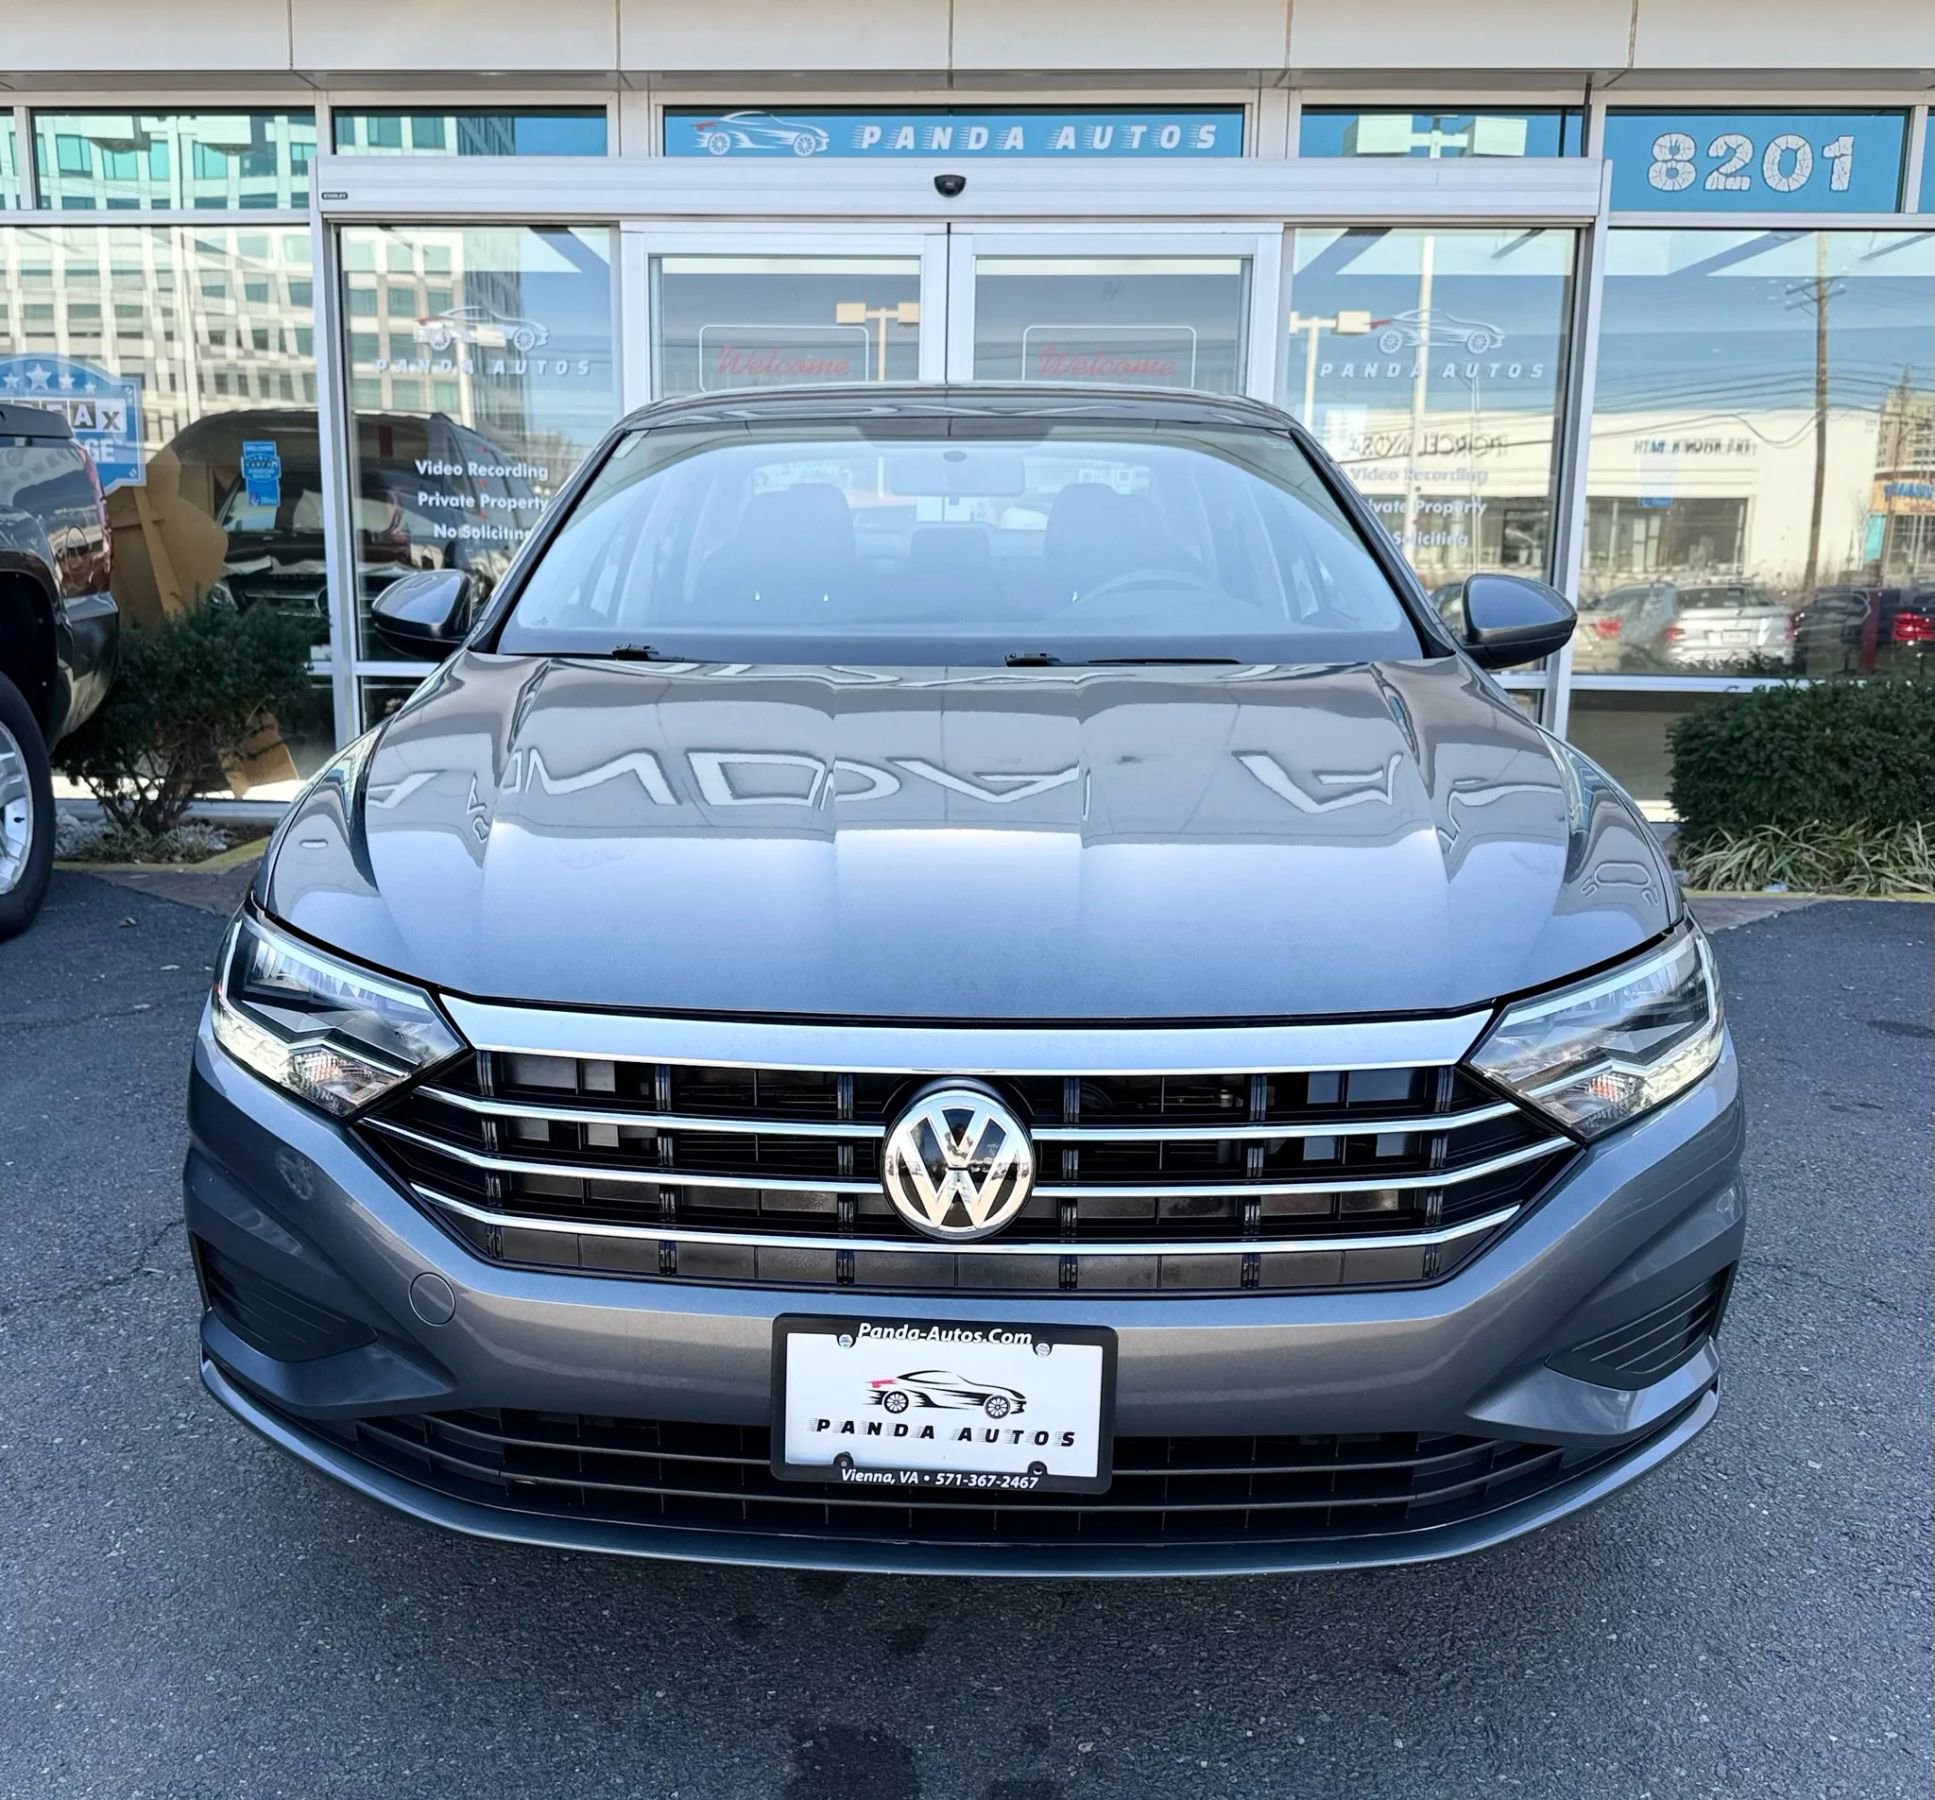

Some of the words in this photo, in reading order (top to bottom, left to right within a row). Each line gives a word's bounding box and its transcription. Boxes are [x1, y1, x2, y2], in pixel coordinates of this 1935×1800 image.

[853, 125, 1024, 150] PANDA
[1050, 125, 1216, 149] AUTOS
[1648, 132, 1854, 192] 8201
[376, 359, 473, 374] PANDA
[492, 360, 590, 375] AUTOS
[717, 344, 850, 375] Welcome
[1040, 342, 1175, 377] Welcome
[1443, 363, 1544, 378] AUTOS
[415, 459, 463, 476] Video
[468, 461, 549, 481] Recording
[1350, 467, 1399, 481] Video
[1404, 467, 1489, 485] Recording
[418, 491, 475, 507] Private
[480, 493, 549, 513] Property
[1415, 500, 1487, 516] Property
[434, 524, 456, 538] No
[857, 1322, 1032, 1346] Panda-Autos.Com
[812, 1417, 935, 1439] PANDA
[950, 1427, 1075, 1447] AUTOS
[841, 1468, 895, 1485] Vienna,
[899, 1471, 919, 1483] VA
[935, 1472, 1039, 1490] 571-367-2467
